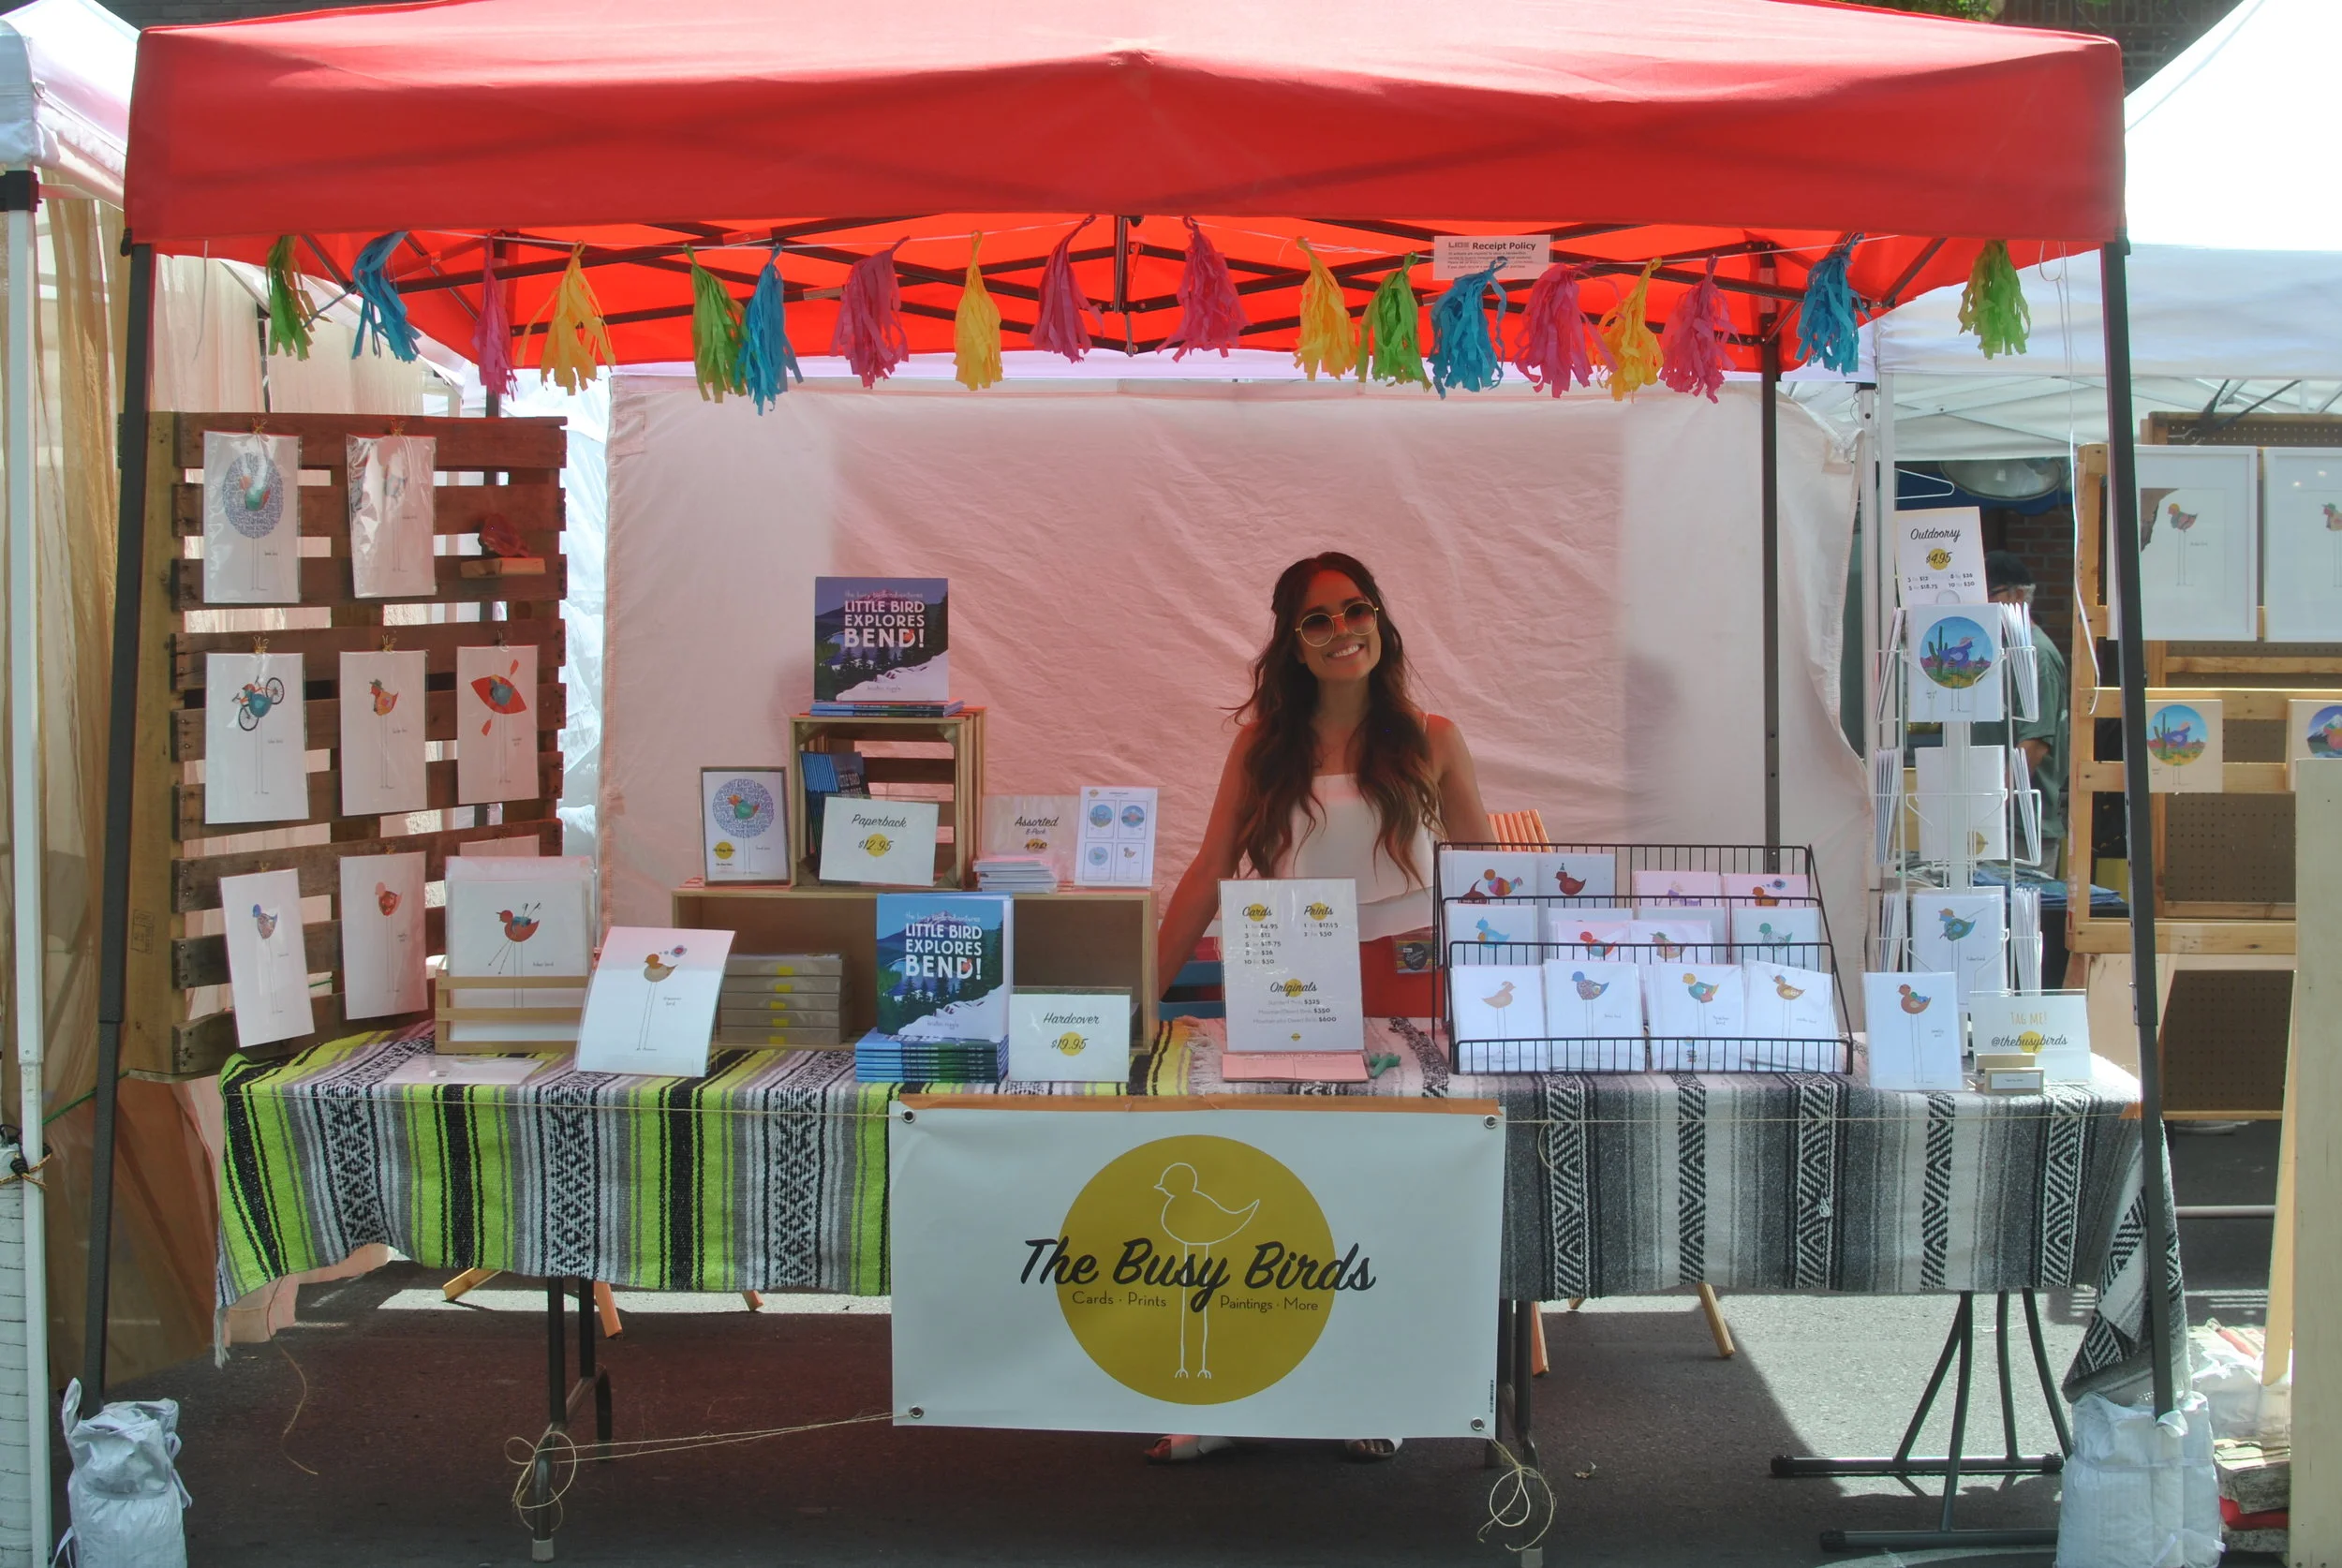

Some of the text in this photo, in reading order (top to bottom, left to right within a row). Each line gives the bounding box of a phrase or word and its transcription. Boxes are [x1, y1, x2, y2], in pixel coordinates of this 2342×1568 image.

[1472, 242, 1506, 251] Receipt
[1508, 242, 1536, 251] Policy
[1910, 527, 1961, 543] Outdoorsy
[1926, 551, 1952, 565] $4.95
[844, 599, 926, 614] LITTLE BIRD
[844, 614, 926, 628] EXPLORES
[844, 628, 925, 648] BEND!
[851, 814, 908, 828] Paperback
[1015, 816, 1060, 827] Assorted
[858, 839, 894, 851] $12.95
[1241, 906, 1273, 918] Cards
[1304, 905, 1334, 916] Prints
[905, 923, 983, 939] LITTLE BIRD
[905, 939, 983, 956] EXPLORES
[905, 954, 982, 980] BEND!
[1269, 982, 1318, 997] Originals
[1043, 1012, 1100, 1025] Hardcover
[1050, 1038, 1089, 1050] $19.95
[1991, 1034, 2068, 1050] @thebusybirds
[1020, 1235, 1377, 1313] The Busy Birds
[1072, 1291, 1319, 1313] Cards Prints Paintings More
